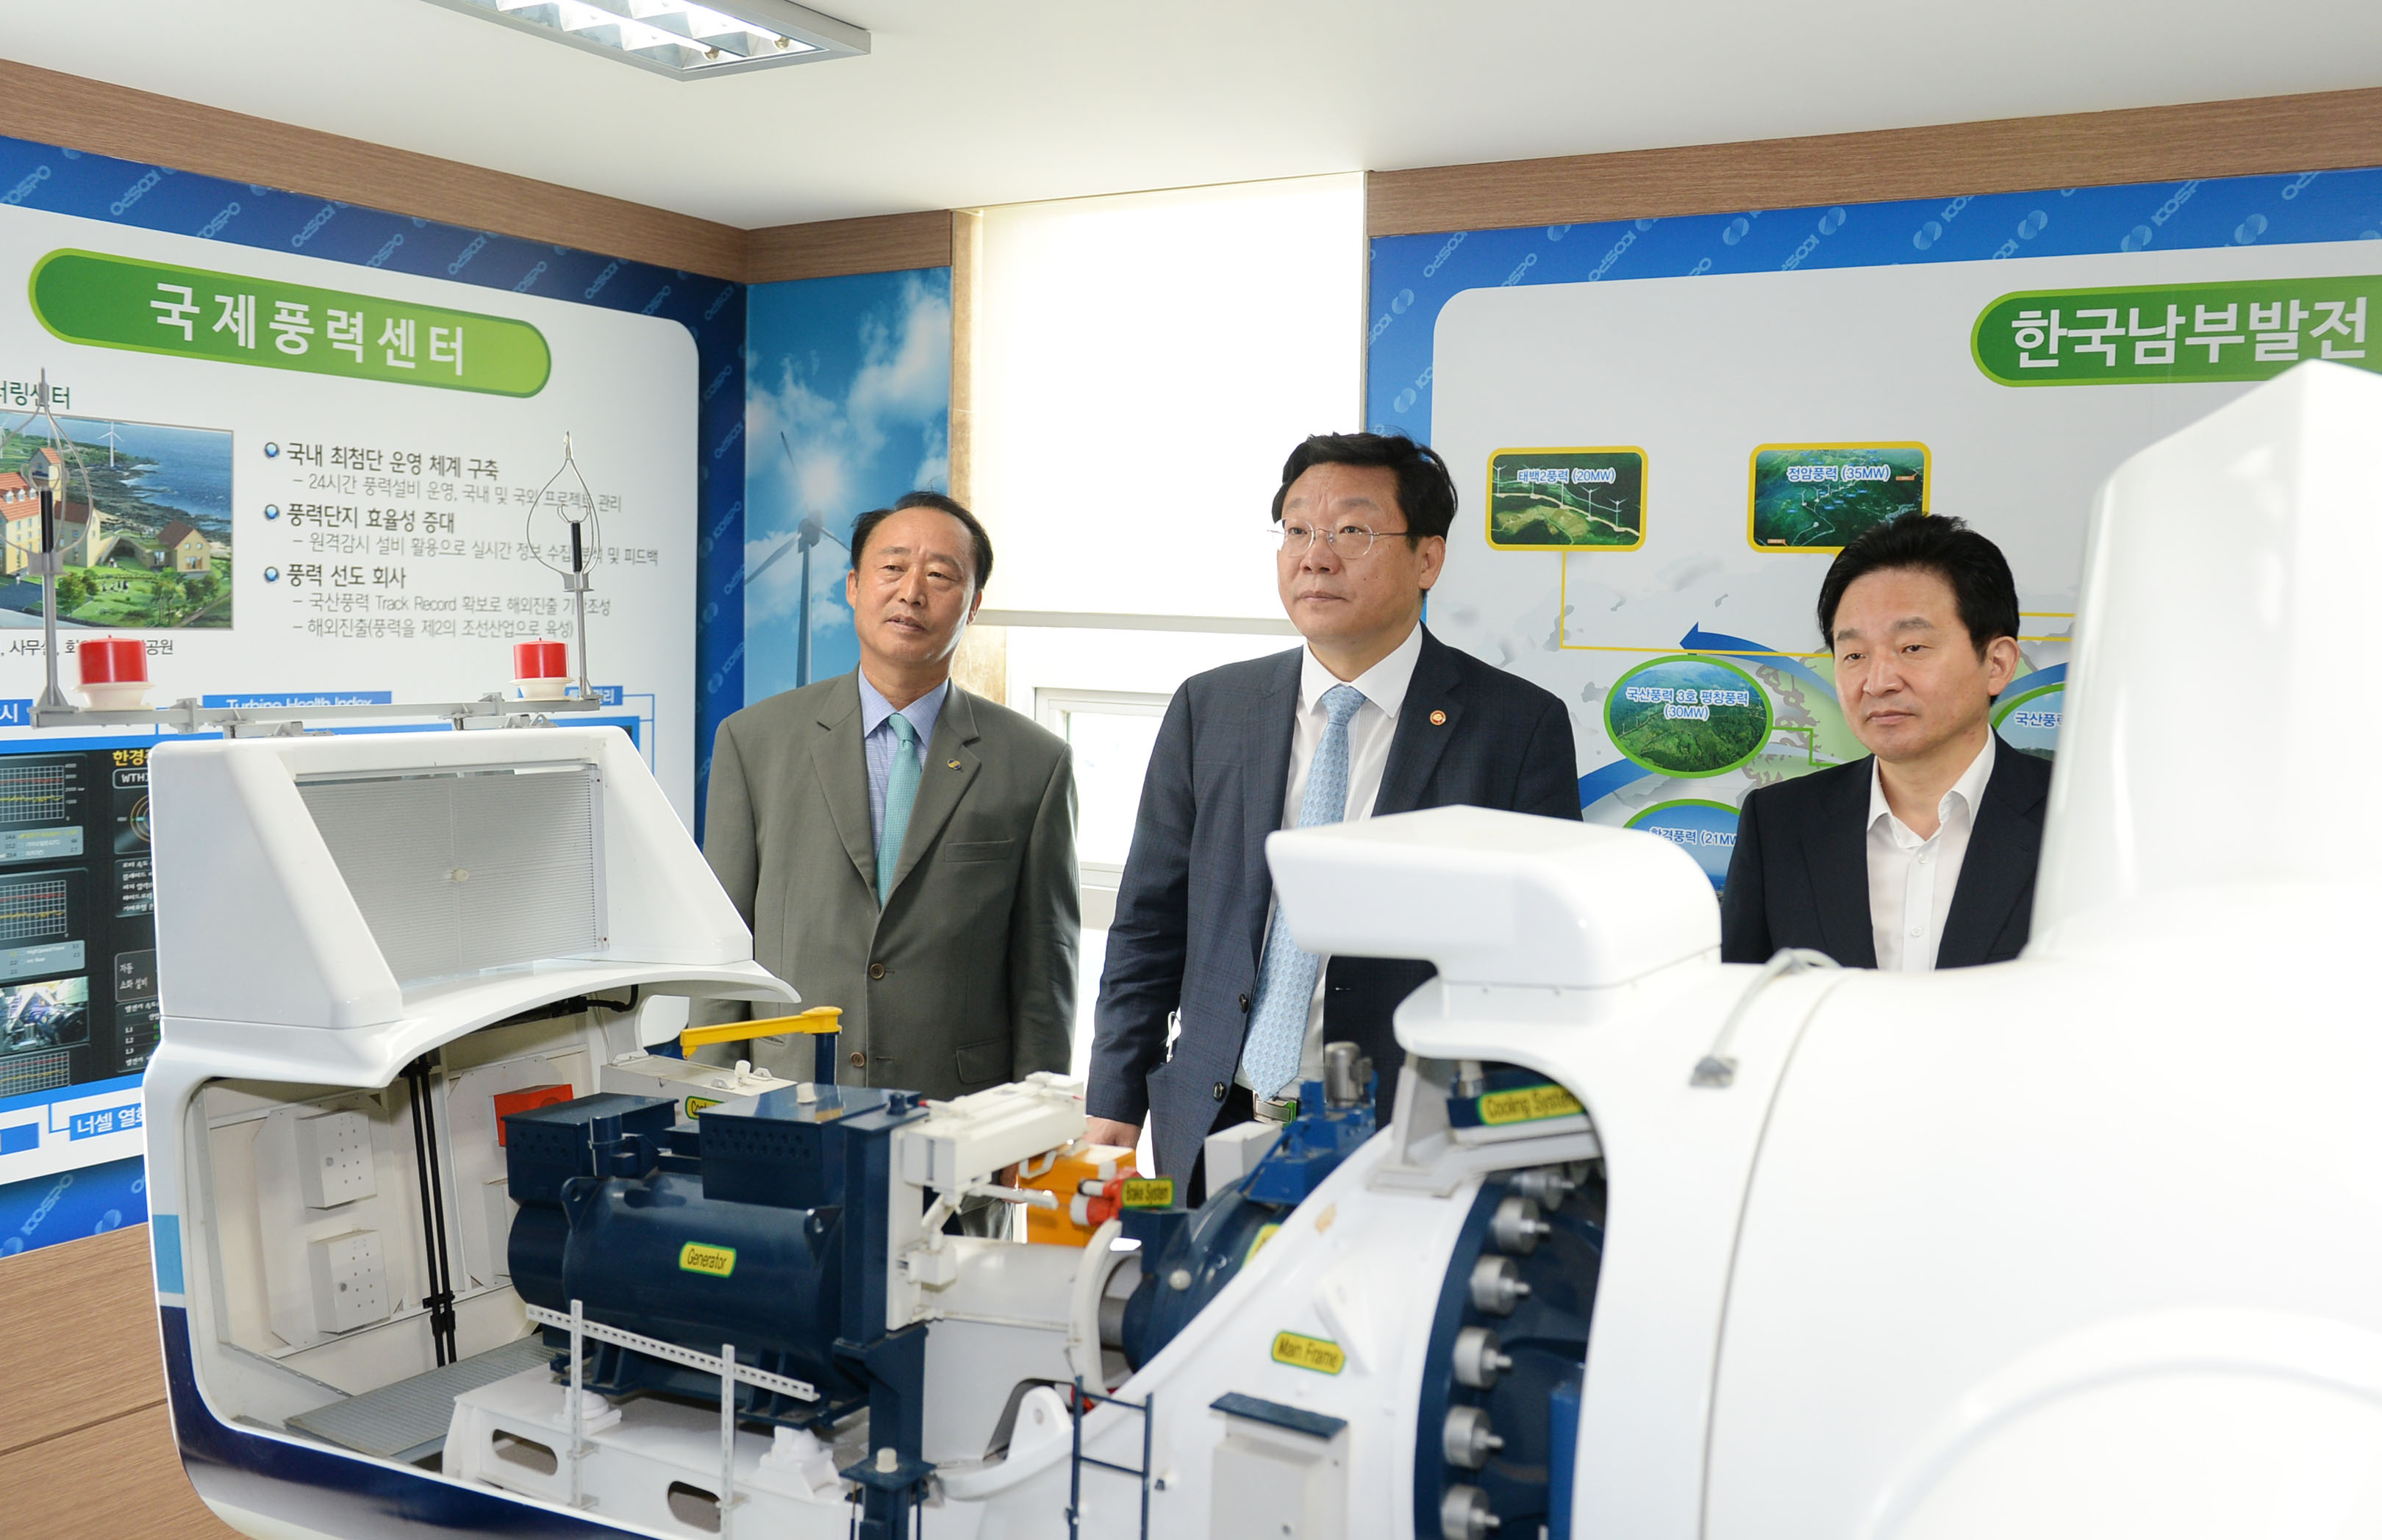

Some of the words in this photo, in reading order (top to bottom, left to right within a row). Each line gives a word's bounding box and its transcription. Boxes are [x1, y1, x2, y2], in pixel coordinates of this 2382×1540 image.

[2151, 179, 2200, 226] KOSP
[150, 282, 462, 376] 국제풍력센터
[2011, 297, 2367, 368] 한국남부발전
[287, 443, 323, 468] 국내
[331, 446, 383, 472] 최첨단
[390, 451, 421, 476] 운영
[429, 455, 461, 478] 체계
[467, 459, 498, 481] 구축
[1788, 467, 1837, 481] 정암풍력
[1842, 465, 1891, 481] (35MW)
[1518, 470, 1569, 483] 태백2풍력
[1573, 468, 1616, 484] (20MW)
[310, 473, 356, 495] 24시간
[362, 476, 421, 499] 풍력설비
[462, 484, 490, 504] 국내
[495, 486, 508, 505] 및
[513, 488, 539, 508] 국외
[598, 494, 622, 513] 관리
[287, 504, 358, 529] 풍력단지
[366, 508, 415, 533] 효율성
[423, 512, 455, 534] 증대
[310, 532, 370, 554] 원격감시
[376, 537, 404, 556] 설비
[412, 538, 466, 557] 활용으로
[473, 540, 511, 560] 실시간
[516, 542, 542, 561] 정보
[608, 547, 620, 565] 및
[624, 548, 659, 567] 피드백
[287, 564, 323, 587] 풍력
[331, 565, 365, 587] 선도
[373, 567, 407, 590] 회사
[310, 592, 370, 613] 국산풍력
[376, 595, 408, 611] Track
[415, 596, 457, 612] Record
[462, 596, 502, 615] 확보로
[507, 598, 557, 616] 해외진출
[563, 598, 610, 617] 기조성
[421, 620, 456, 637] 제2의
[462, 620, 541, 638] 조선산업으로
[1626, 687, 1673, 703] 국산풍력
[1678, 690, 1696, 703] 3호
[1701, 690, 1749, 706] 평창풍력
[1664, 706, 1709, 721] (30MW)
[77, 1111, 113, 1135] 너셀
[20, 1174, 74, 1236] KOSPO
[687, 1249, 727, 1270] Generator
[1279, 1339, 1303, 1359] Main
[1306, 1342, 1339, 1368] Frame
